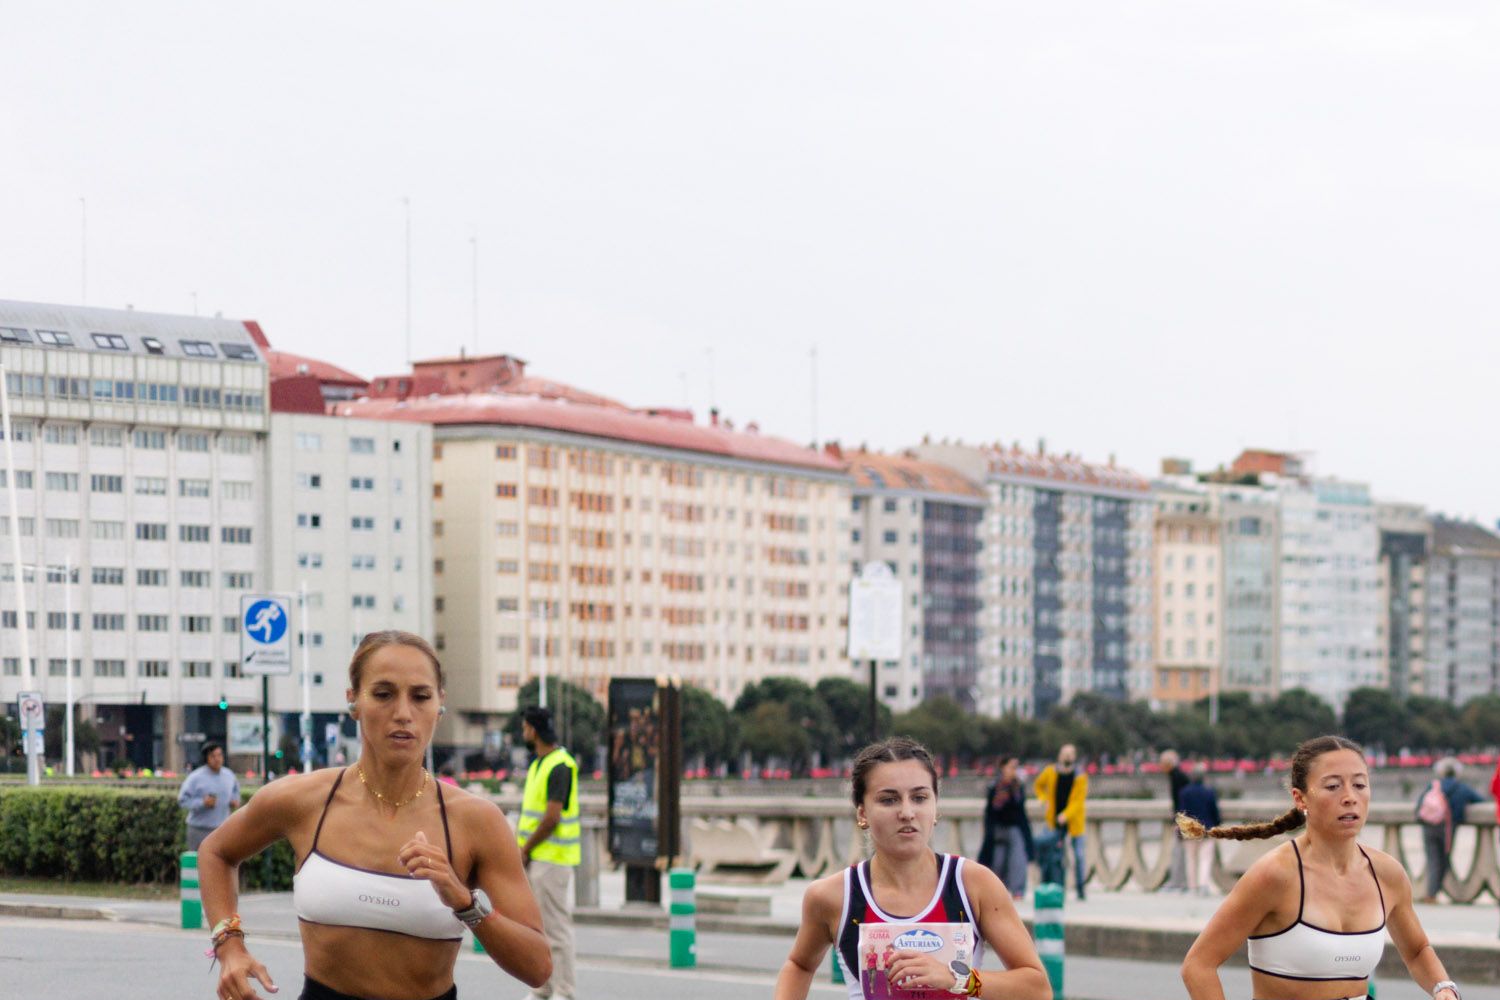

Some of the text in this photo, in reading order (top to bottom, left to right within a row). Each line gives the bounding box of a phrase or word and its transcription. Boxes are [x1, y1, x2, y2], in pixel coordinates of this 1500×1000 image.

[358, 894, 400, 907] OYSHO
[868, 932, 890, 940] SUMA
[911, 991, 925, 999] 711
